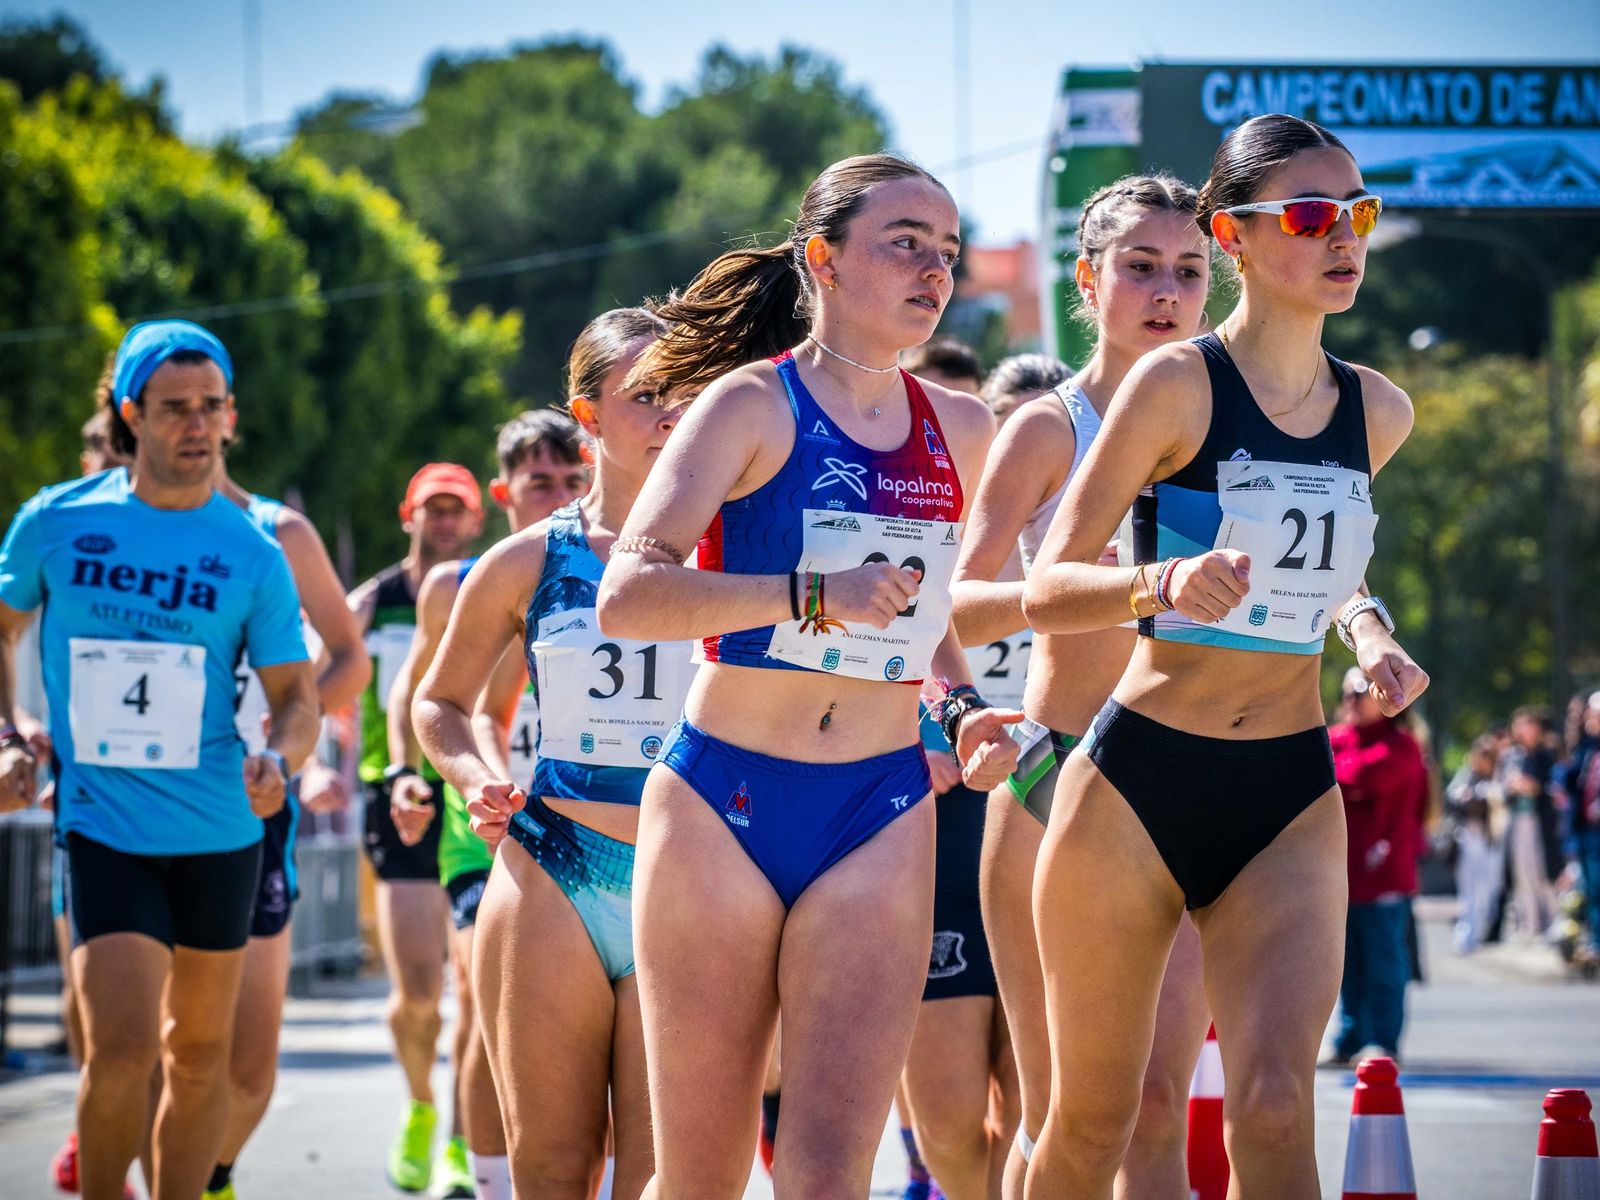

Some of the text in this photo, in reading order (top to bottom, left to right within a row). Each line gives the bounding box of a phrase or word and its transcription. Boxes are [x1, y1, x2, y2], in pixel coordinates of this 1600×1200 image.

[1202, 70, 1482, 125] CAMPEONATO
[1489, 71, 1546, 125] DE
[877, 473, 954, 499] lapalma
[902, 496, 954, 508] cooperativa
[874, 516, 904, 525] CAMPEONATO
[1273, 507, 1335, 571] 21
[70, 557, 218, 613] nerja
[1270, 589, 1296, 598] HELENA
[88, 601, 194, 635] ATLETISMO
[854, 633, 881, 642] GUZMAN
[881, 637, 911, 645] MARTINEZ
[588, 642, 663, 701] 31
[123, 672, 150, 715] 4
[635, 719, 666, 727] SANCHEZ
